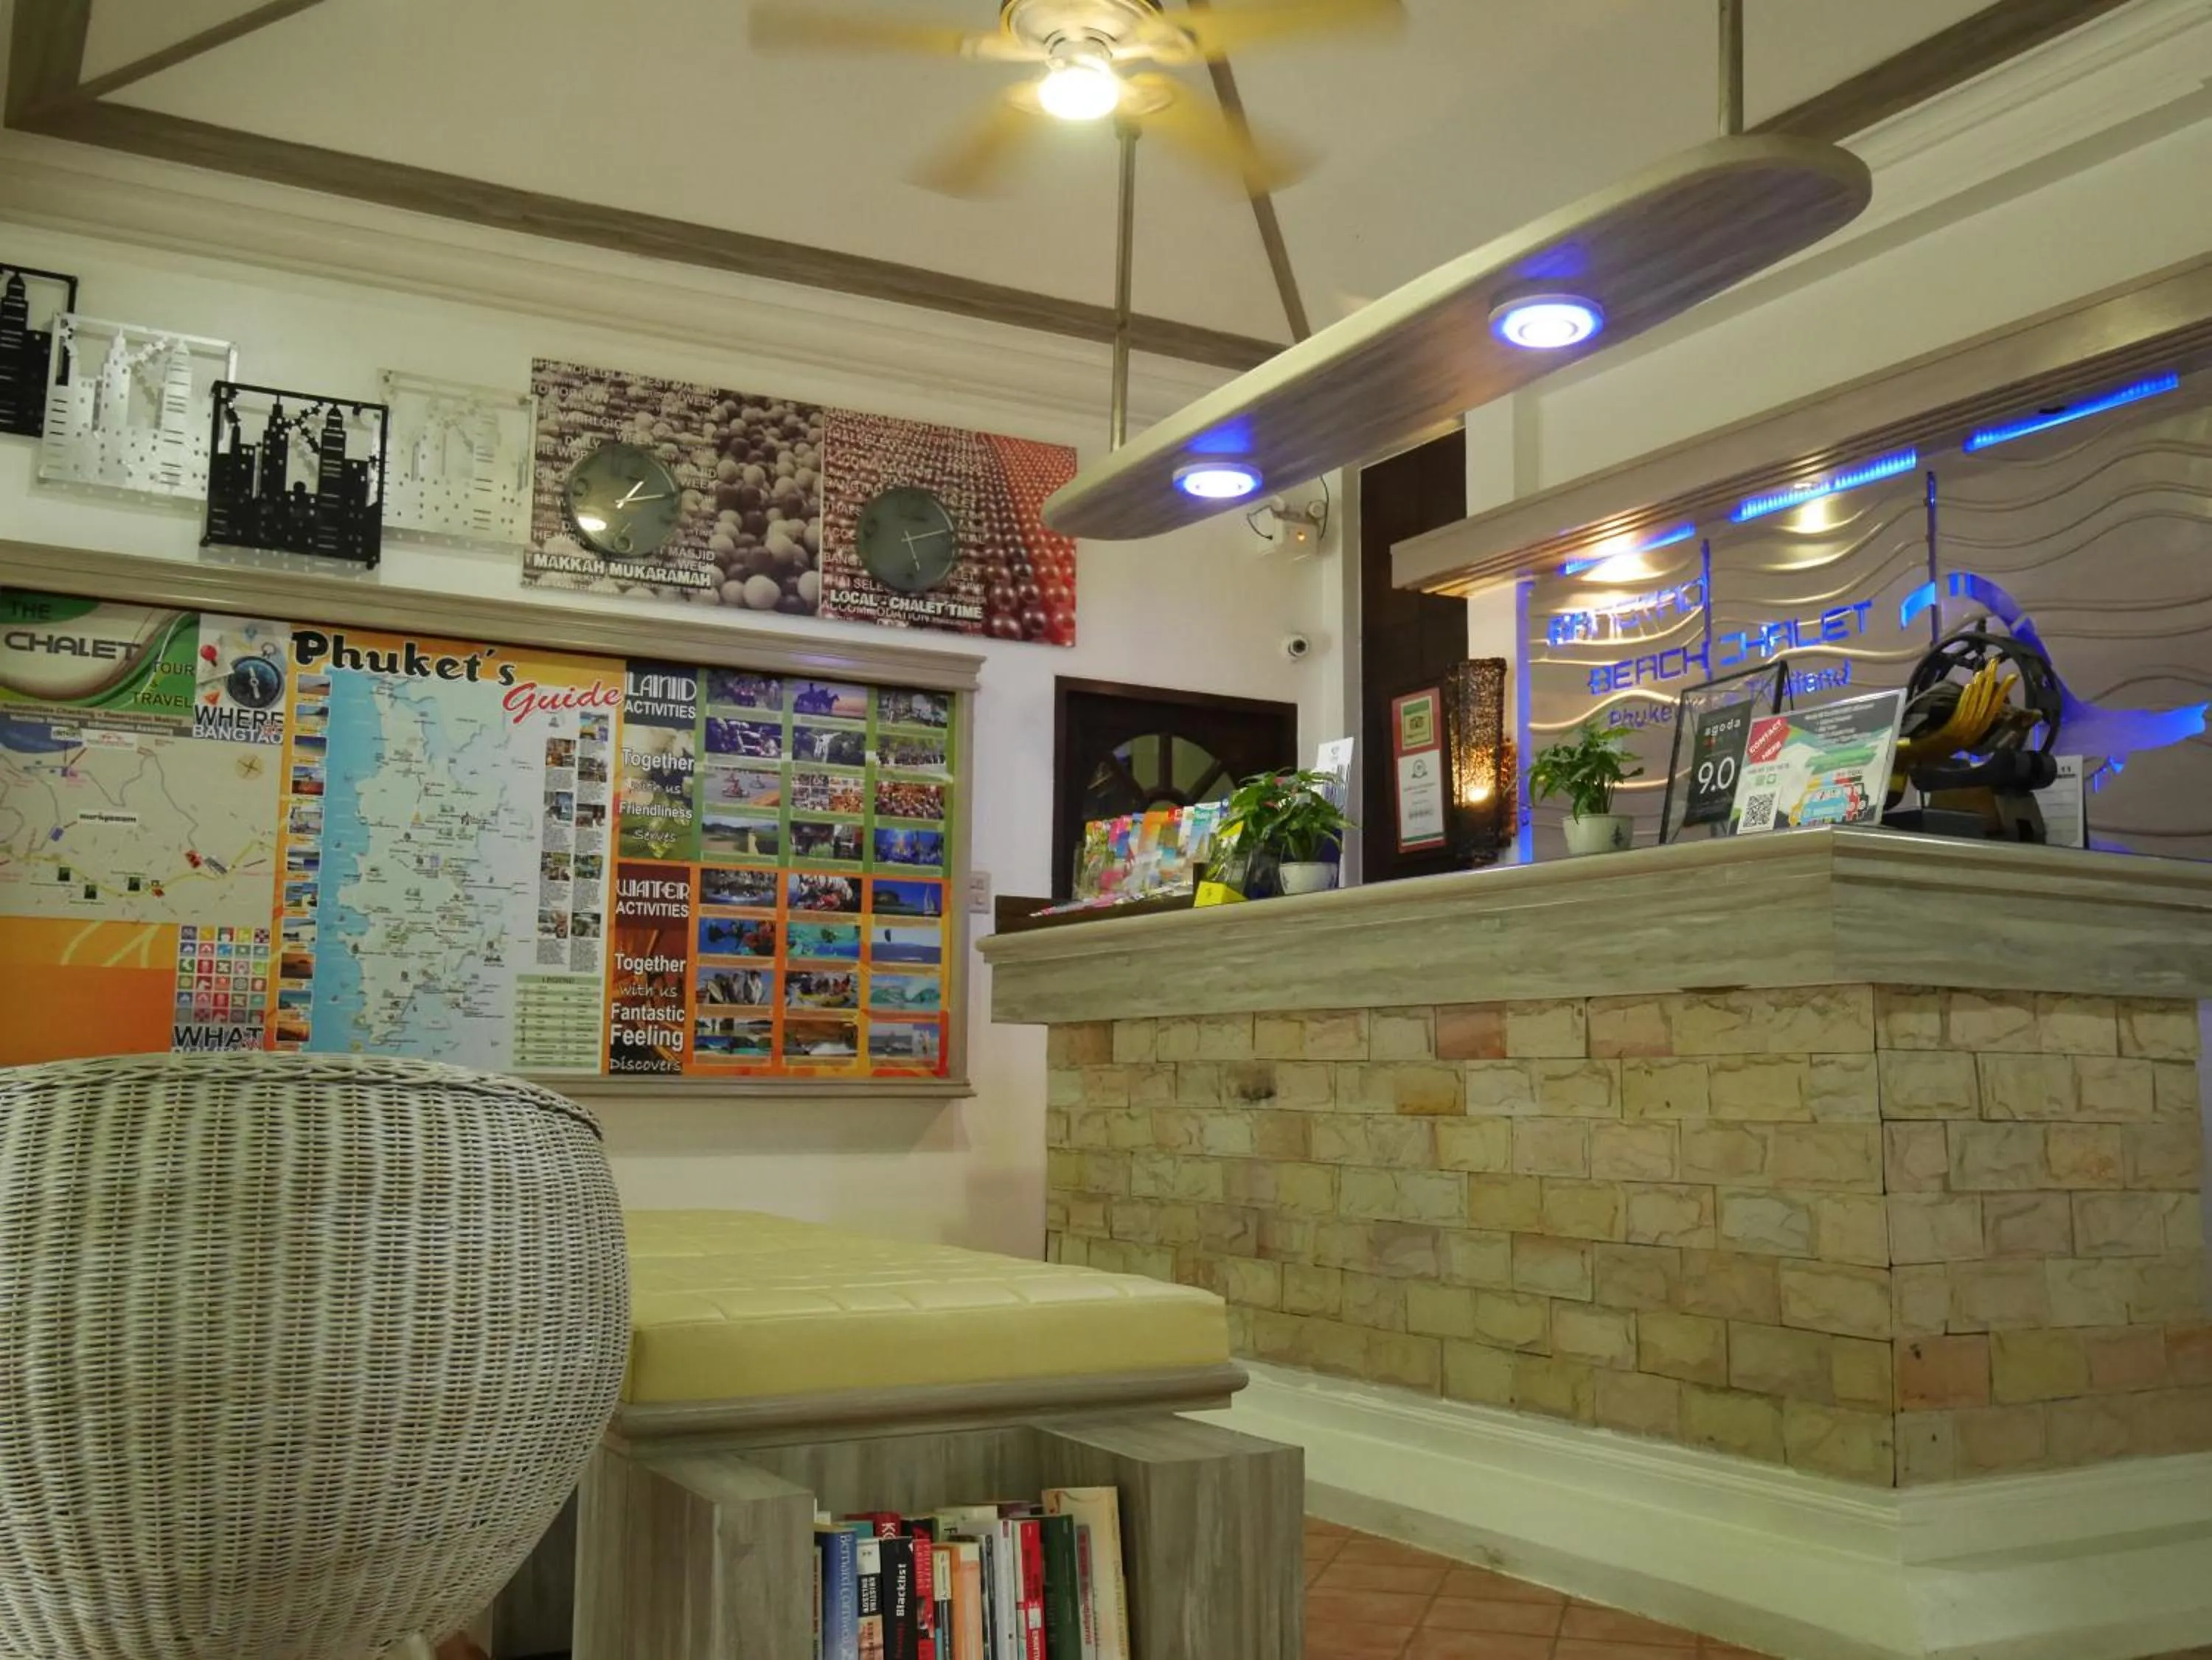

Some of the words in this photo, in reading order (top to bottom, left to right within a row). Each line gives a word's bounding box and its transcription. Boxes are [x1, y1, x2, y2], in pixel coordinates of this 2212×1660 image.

[533, 554, 605, 574] MAKKAH
[609, 562, 712, 587] MUKARAMAH
[11, 599, 52, 620] THE
[830, 590, 878, 607] LOCAL
[4, 631, 142, 660] CHALET
[153, 660, 195, 676] TOUR
[291, 630, 516, 686] Phuket's
[1588, 641, 1711, 695] BEACH
[627, 672, 697, 701] LAND
[132, 692, 194, 708] TRAVEL
[502, 681, 623, 724] Guide
[625, 700, 696, 719] ACTIVITIES
[194, 704, 284, 732] WHERE
[1705, 718, 1742, 736] agoda
[192, 724, 284, 744] BANGTAO
[622, 747, 695, 771] Together
[1697, 756, 1736, 794] 9.0
[619, 801, 692, 819] Friendliness
[616, 879, 690, 900] WATER
[616, 901, 689, 918] ACTIVITIES
[614, 953, 686, 975] Together
[621, 982, 654, 997] with
[660, 986, 678, 997] us
[611, 1002, 685, 1022] Fantastic
[174, 1025, 264, 1049] WHAT
[611, 1023, 684, 1052] Feeling
[610, 1056, 682, 1072] Discovers
[839, 1533, 853, 1586] Bernard
[896, 1563, 907, 1617] Blacklist
